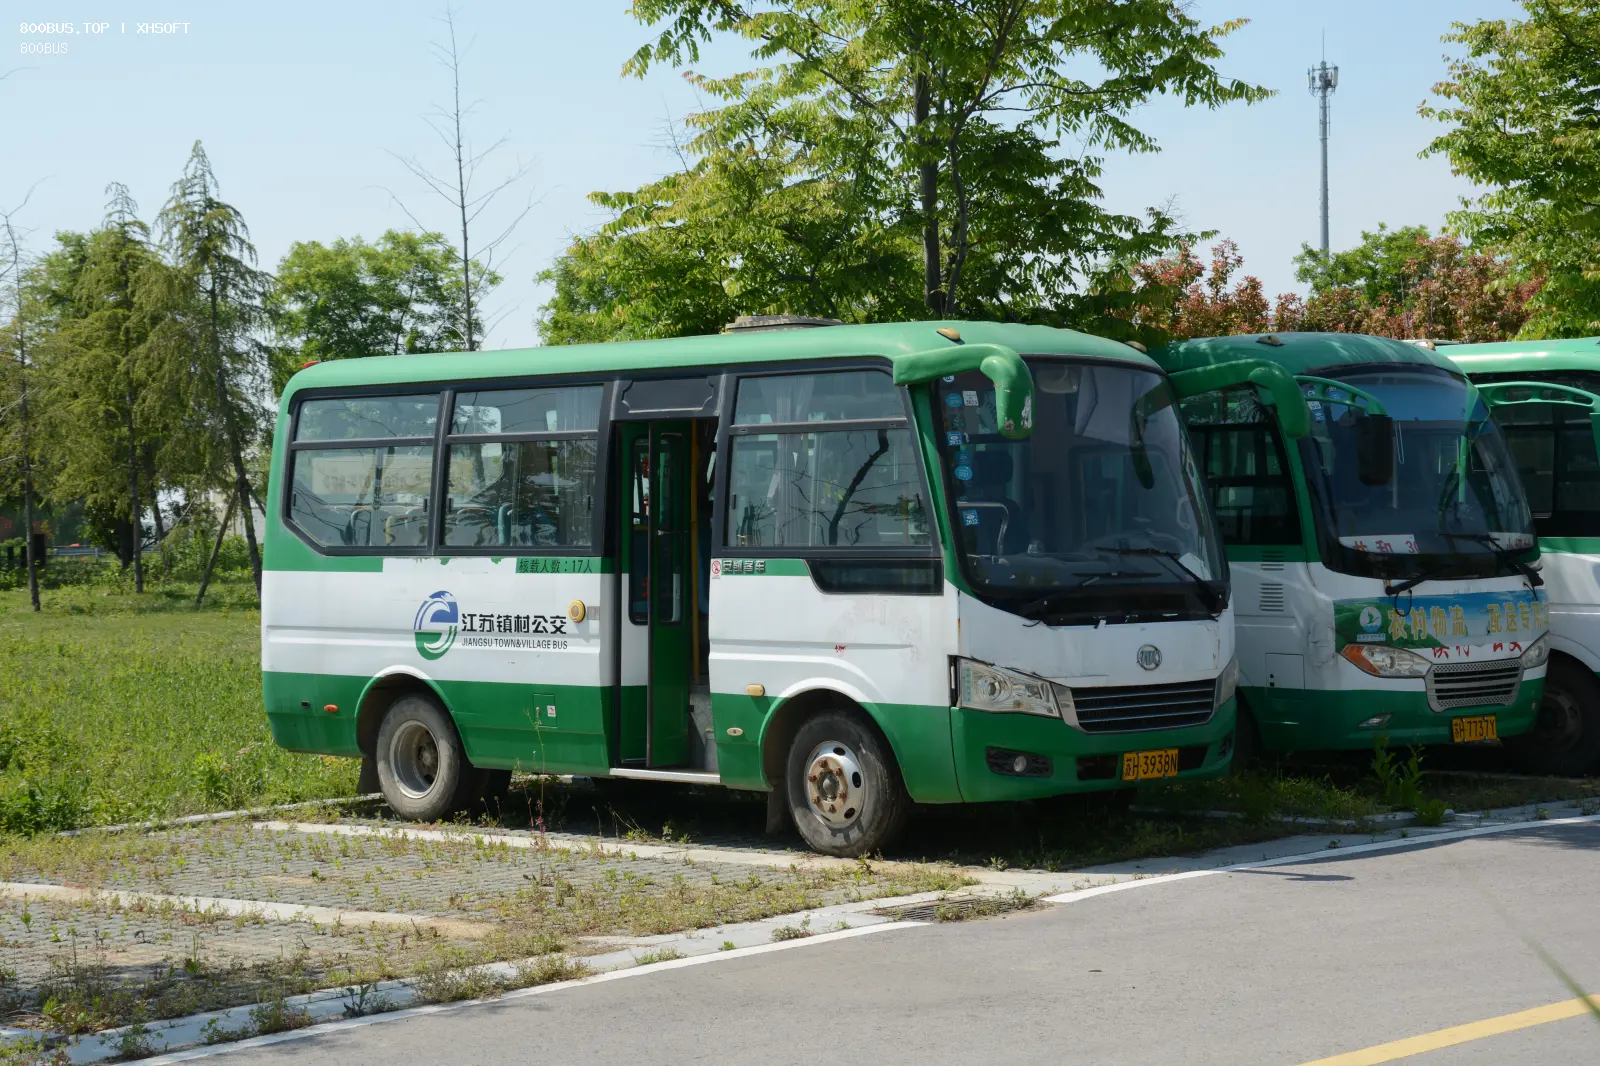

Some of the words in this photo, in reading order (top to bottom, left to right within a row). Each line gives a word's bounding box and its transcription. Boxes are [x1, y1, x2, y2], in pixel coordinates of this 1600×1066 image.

[723, 560, 766, 573] 安凯客车
[461, 613, 567, 635] 江苏镇村公交
[1387, 605, 1467, 641] 农村物流
[461, 637, 493, 648] JIANGSU
[494, 638, 551, 649] TOWN&VILLAGE
[552, 640, 568, 650] BUS
